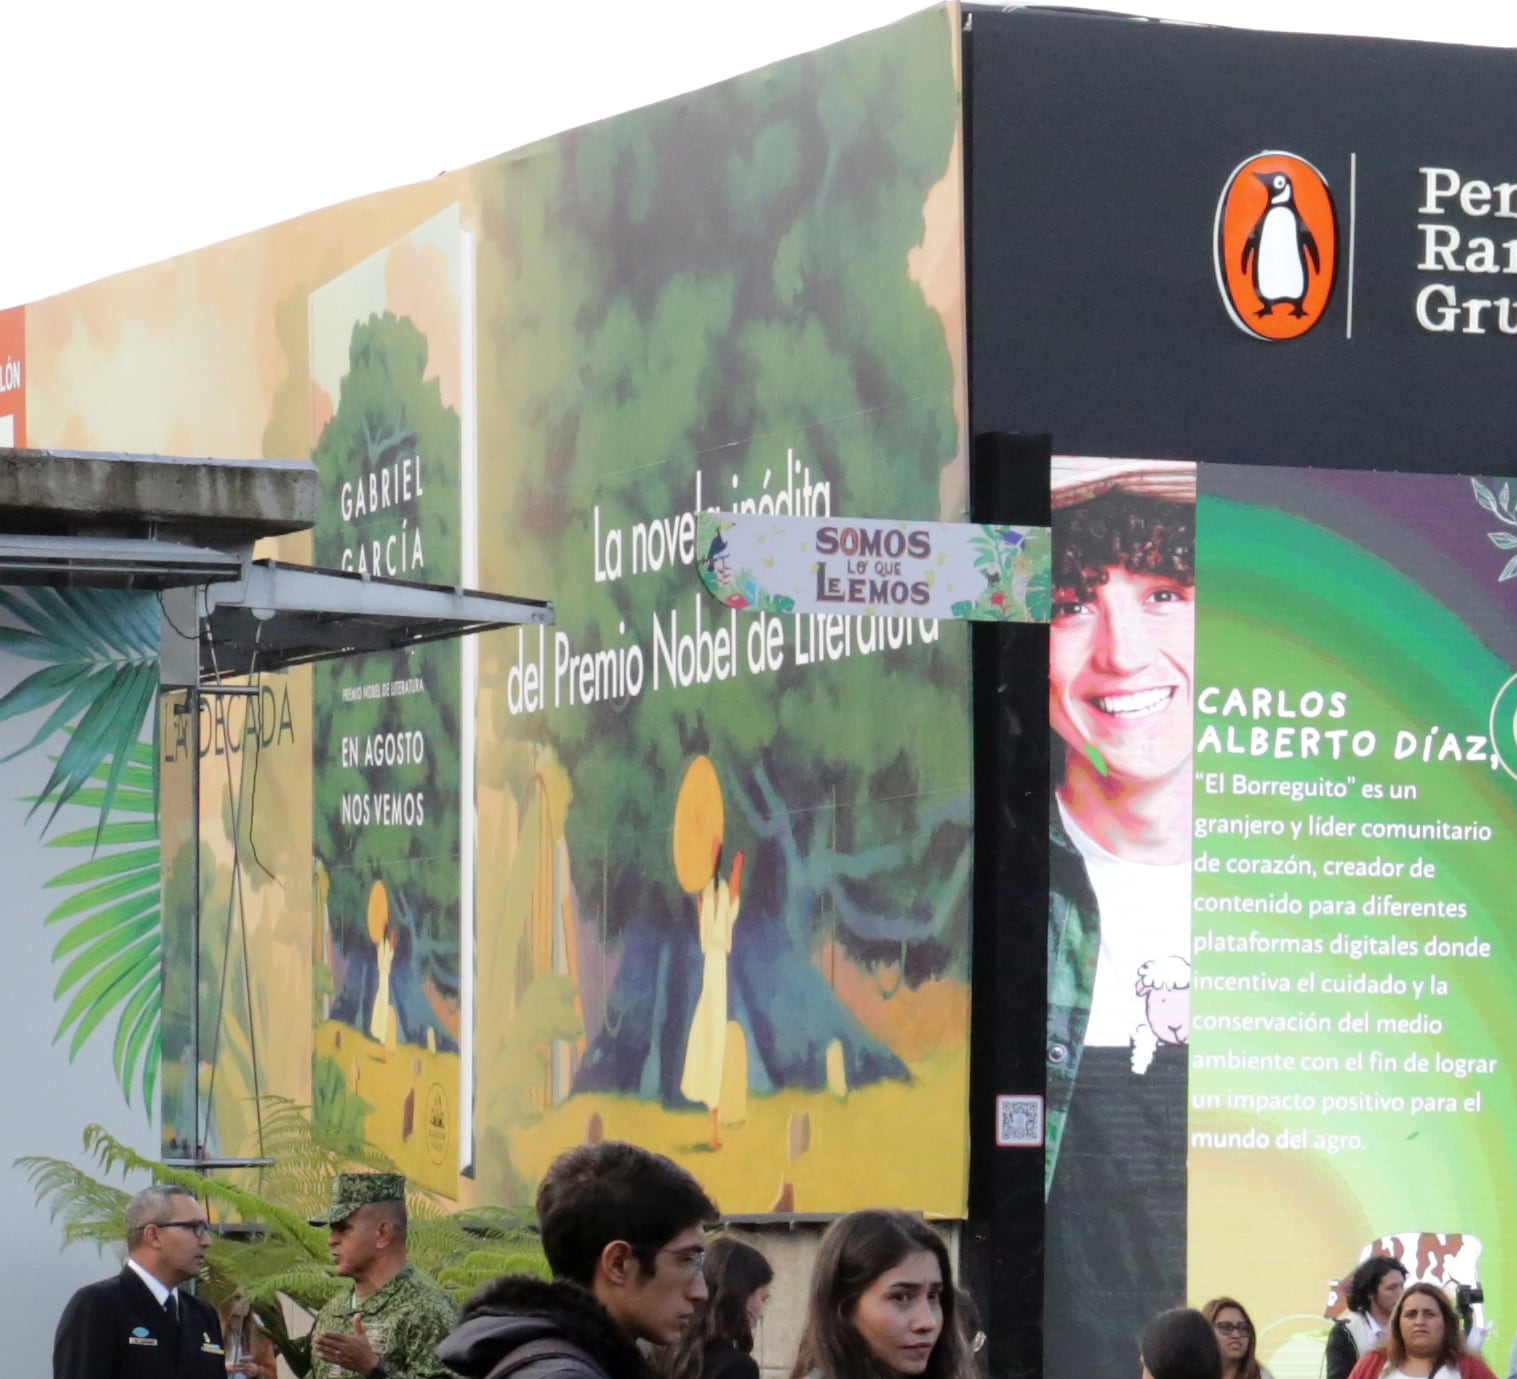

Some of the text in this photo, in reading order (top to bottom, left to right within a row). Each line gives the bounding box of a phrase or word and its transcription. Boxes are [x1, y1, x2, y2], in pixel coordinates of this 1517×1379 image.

[341, 455, 424, 522] GABRIEL
[341, 518, 425, 577] GARCÍA
[593, 505, 623, 582] La
[815, 526, 932, 560] SOMOS
[507, 593, 940, 715] del Premio Nobel de Literatura
[1197, 686, 1347, 719] CARLOS
[342, 730, 425, 768] EN AGOSTO
[1196, 726, 1500, 771] ALBERTO DÍAZ,
[1361, 781, 1384, 799] es
[1388, 782, 1417, 800] un
[342, 792, 425, 826] NOS VEMOS
[1194, 814, 1492, 843] granjero y líder comunitario
[1193, 853, 1436, 879] de corazón, creador de
[1193, 893, 1468, 920] contenido para diferentes
[1193, 932, 1492, 960] plataformas digitales donde
[1192, 973, 1449, 1001] incentiva el cuidado y la
[1192, 1011, 1443, 1035] conservación del medio
[1191, 1051, 1498, 1081] ambiente con el fin de lograr
[1191, 1091, 1482, 1119] un impacto positivo para el
[1191, 1129, 1367, 1156] mundo del agro.
